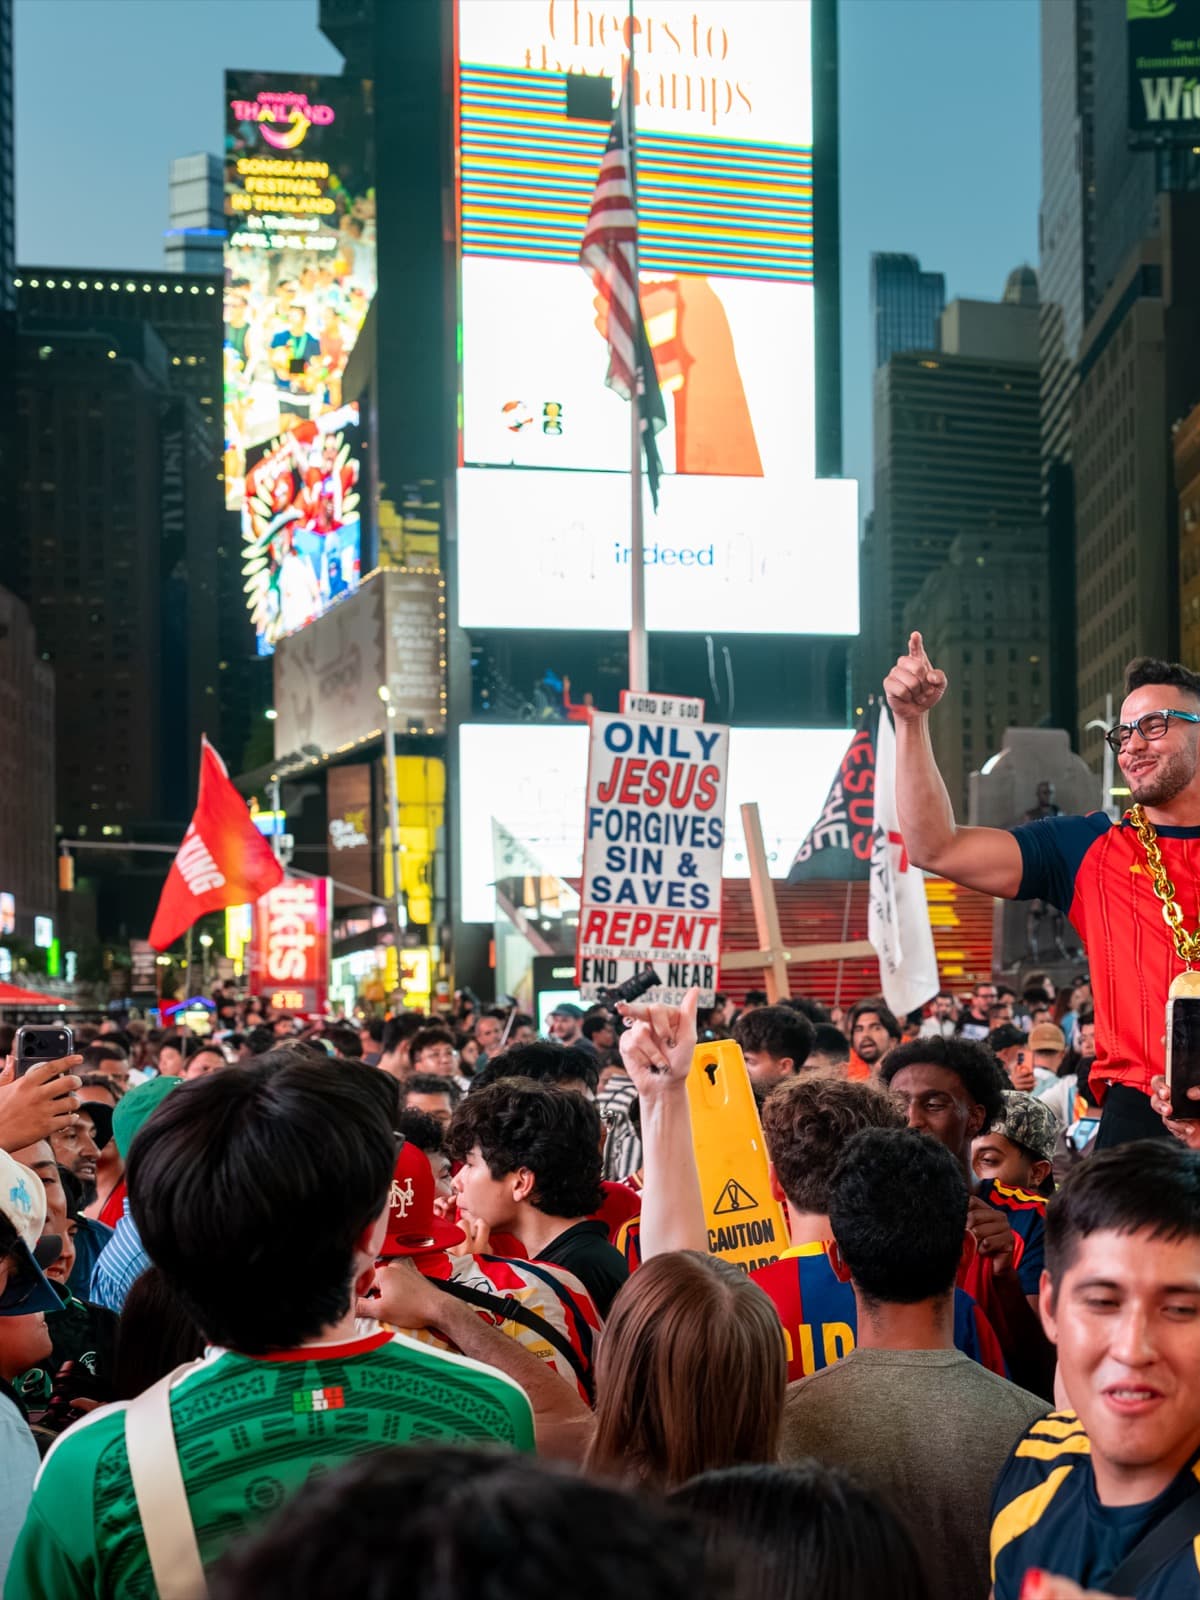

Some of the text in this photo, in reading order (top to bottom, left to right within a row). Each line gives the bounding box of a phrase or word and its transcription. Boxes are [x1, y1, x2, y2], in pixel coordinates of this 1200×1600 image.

[231, 100, 335, 126] THAILAND
[252, 195, 336, 214] THAILAND
[614, 542, 713, 566] indeed
[630, 698, 699, 719] WORD OF GOD
[604, 721, 721, 761] ONLY
[597, 756, 720, 812] JESUS
[588, 807, 723, 849] FORGIVES
[605, 846, 699, 878] SIN &
[591, 876, 710, 909] SAVES
[268, 884, 319, 981] tkts
[583, 910, 718, 951] REPENT
[619, 949, 650, 959] AWAY
[654, 951, 687, 961] FROM
[691, 953, 711, 963] SIN
[582, 958, 618, 984] END
[668, 963, 714, 989] NEAR
[707, 1218, 775, 1253] CAUTION
